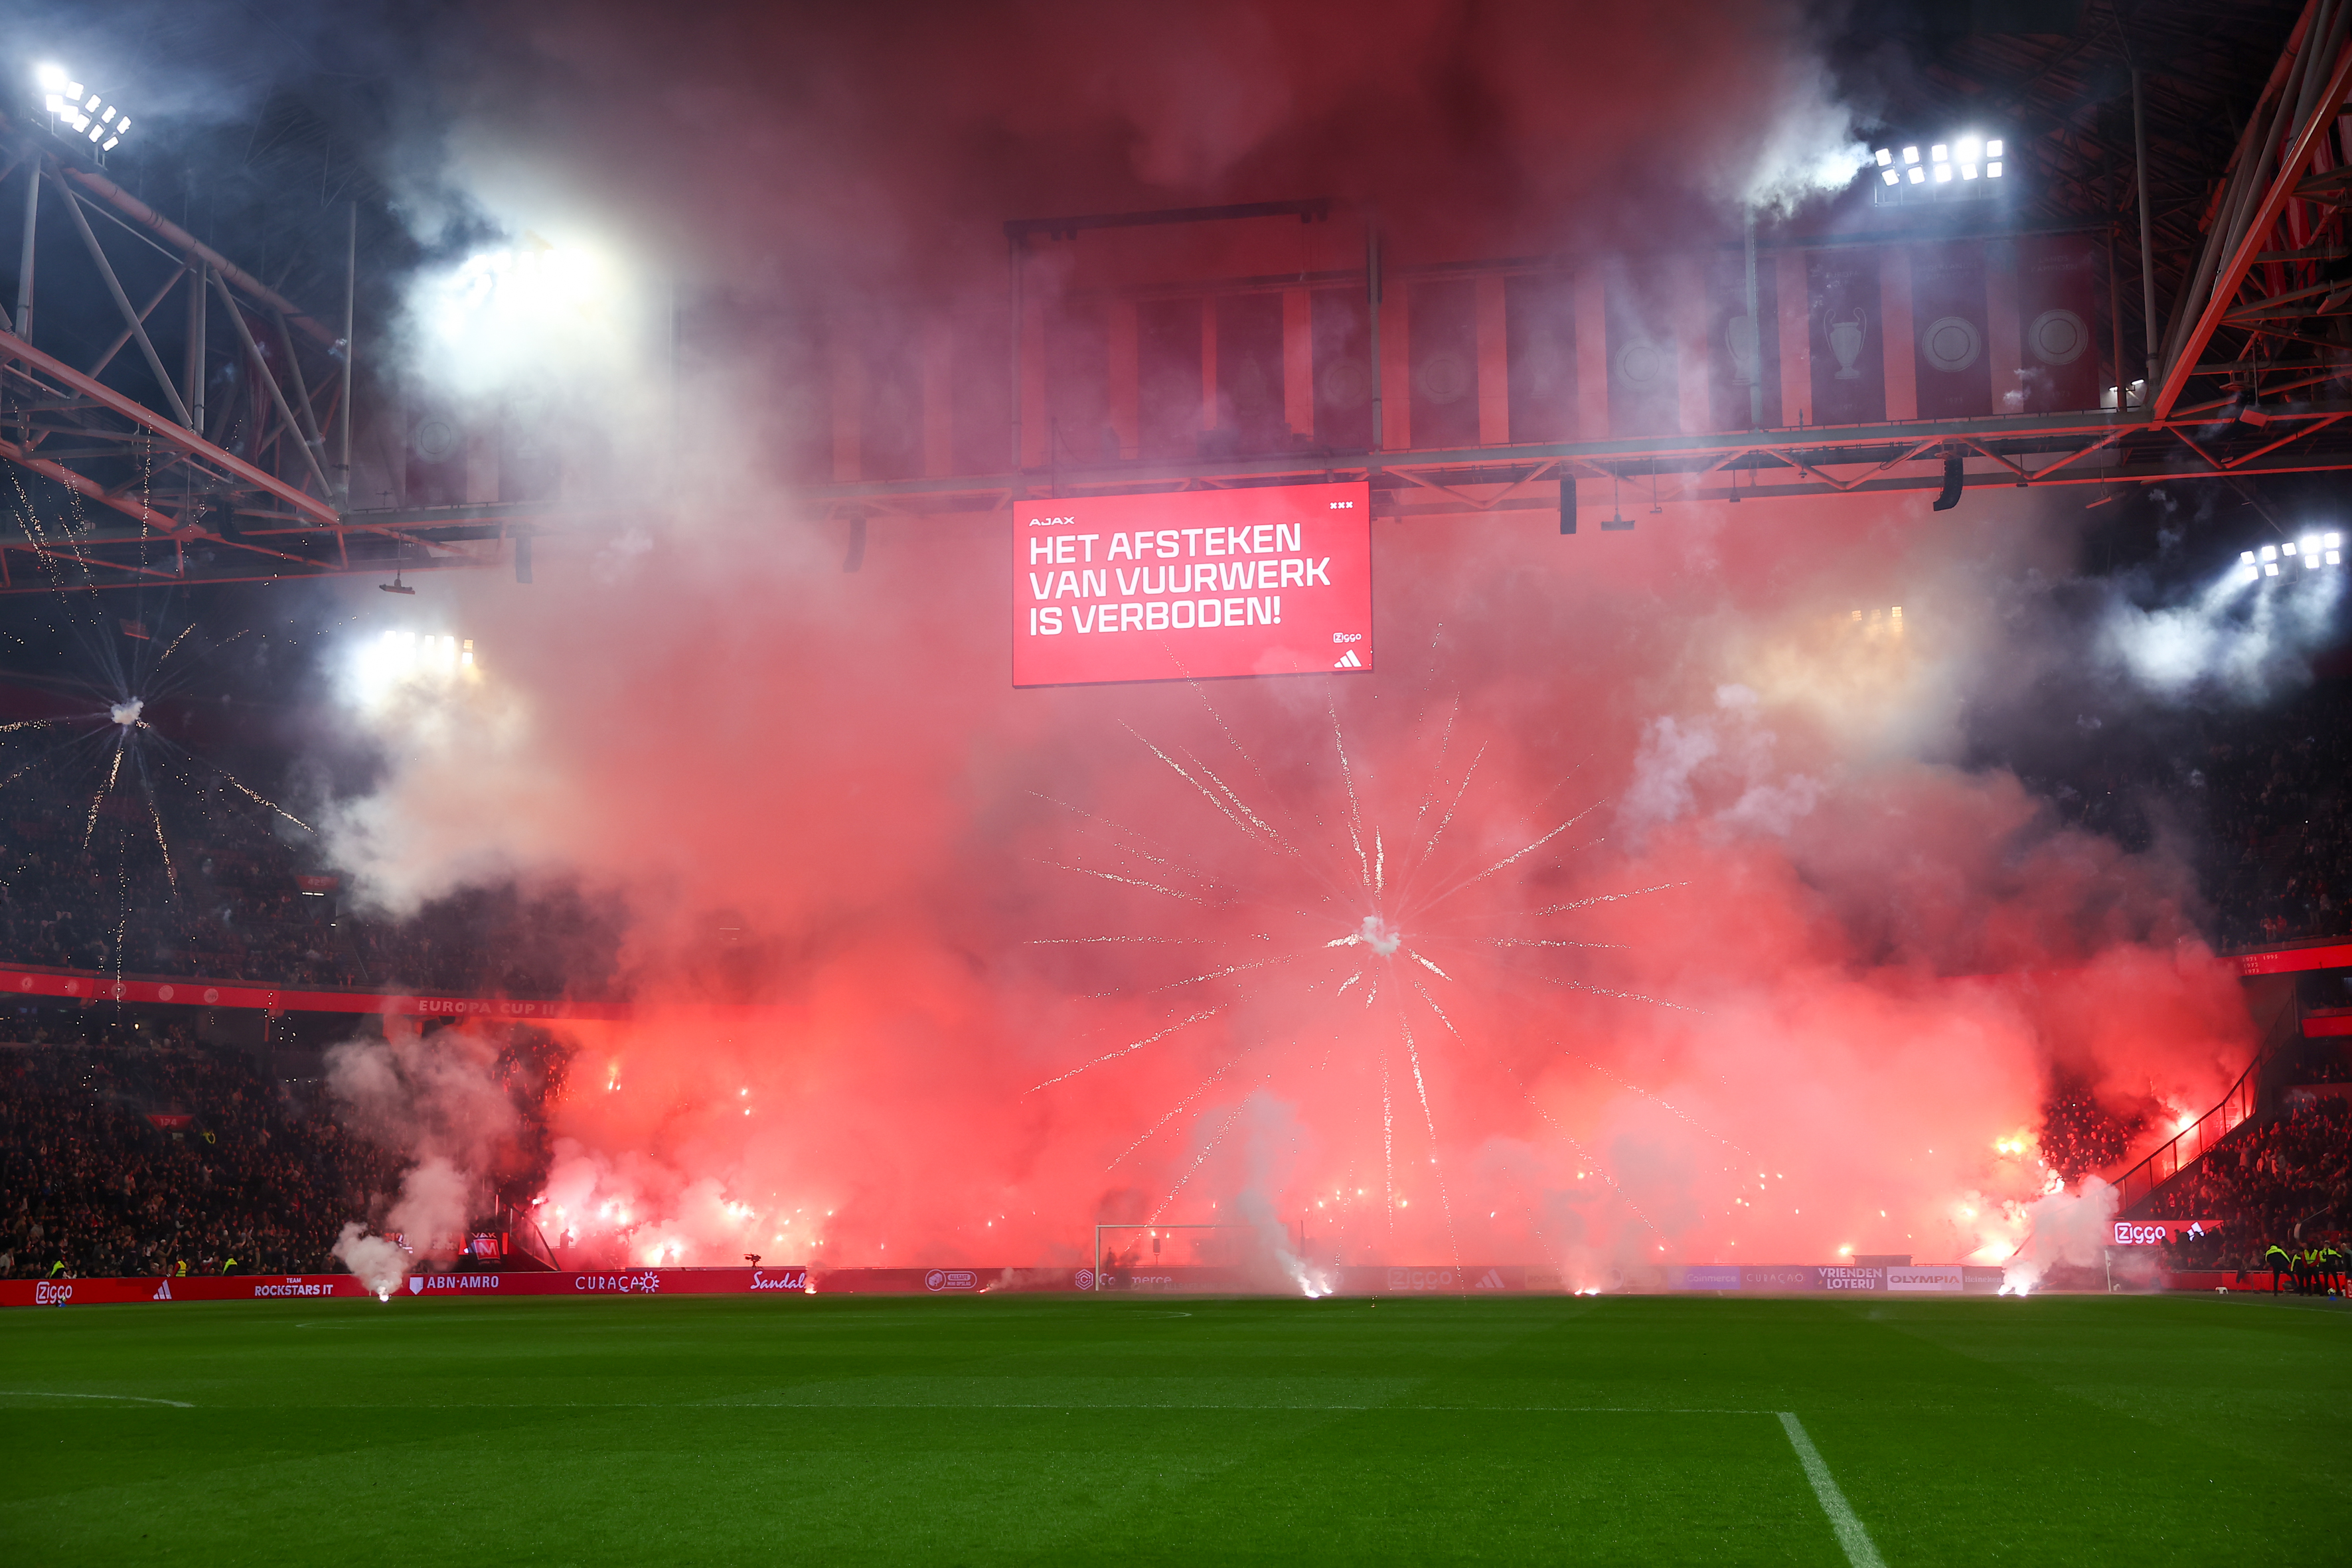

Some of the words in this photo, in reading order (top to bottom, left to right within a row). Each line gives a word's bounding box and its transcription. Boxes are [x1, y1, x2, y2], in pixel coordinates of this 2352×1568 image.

[1028, 516, 1075, 526] AJAX
[1030, 534, 1099, 565] HET
[1107, 522, 1301, 561] AFSTEKEN
[1029, 568, 1107, 600] VAN
[1115, 556, 1331, 596] VUURWERK
[1030, 606, 1063, 636] IS
[1071, 595, 1282, 634] VERBODEN!
[418, 1000, 491, 1014] EUROPA
[499, 1002, 536, 1014] CUP
[542, 1004, 554, 1015] II
[1099, 1273, 1172, 1285] Comerce
[1687, 1273, 1737, 1283] Coinmerce
[1746, 1273, 1804, 1284] CURAÇAO
[1818, 1267, 1883, 1279] VRIENDEN
[1889, 1275, 1960, 1283] OLYMPIA
[750, 1271, 806, 1289] Sandal
[1827, 1278, 1875, 1290] LOTERIJ
[254, 1285, 321, 1296] ROCKSTARS
[323, 1284, 333, 1294] IT
